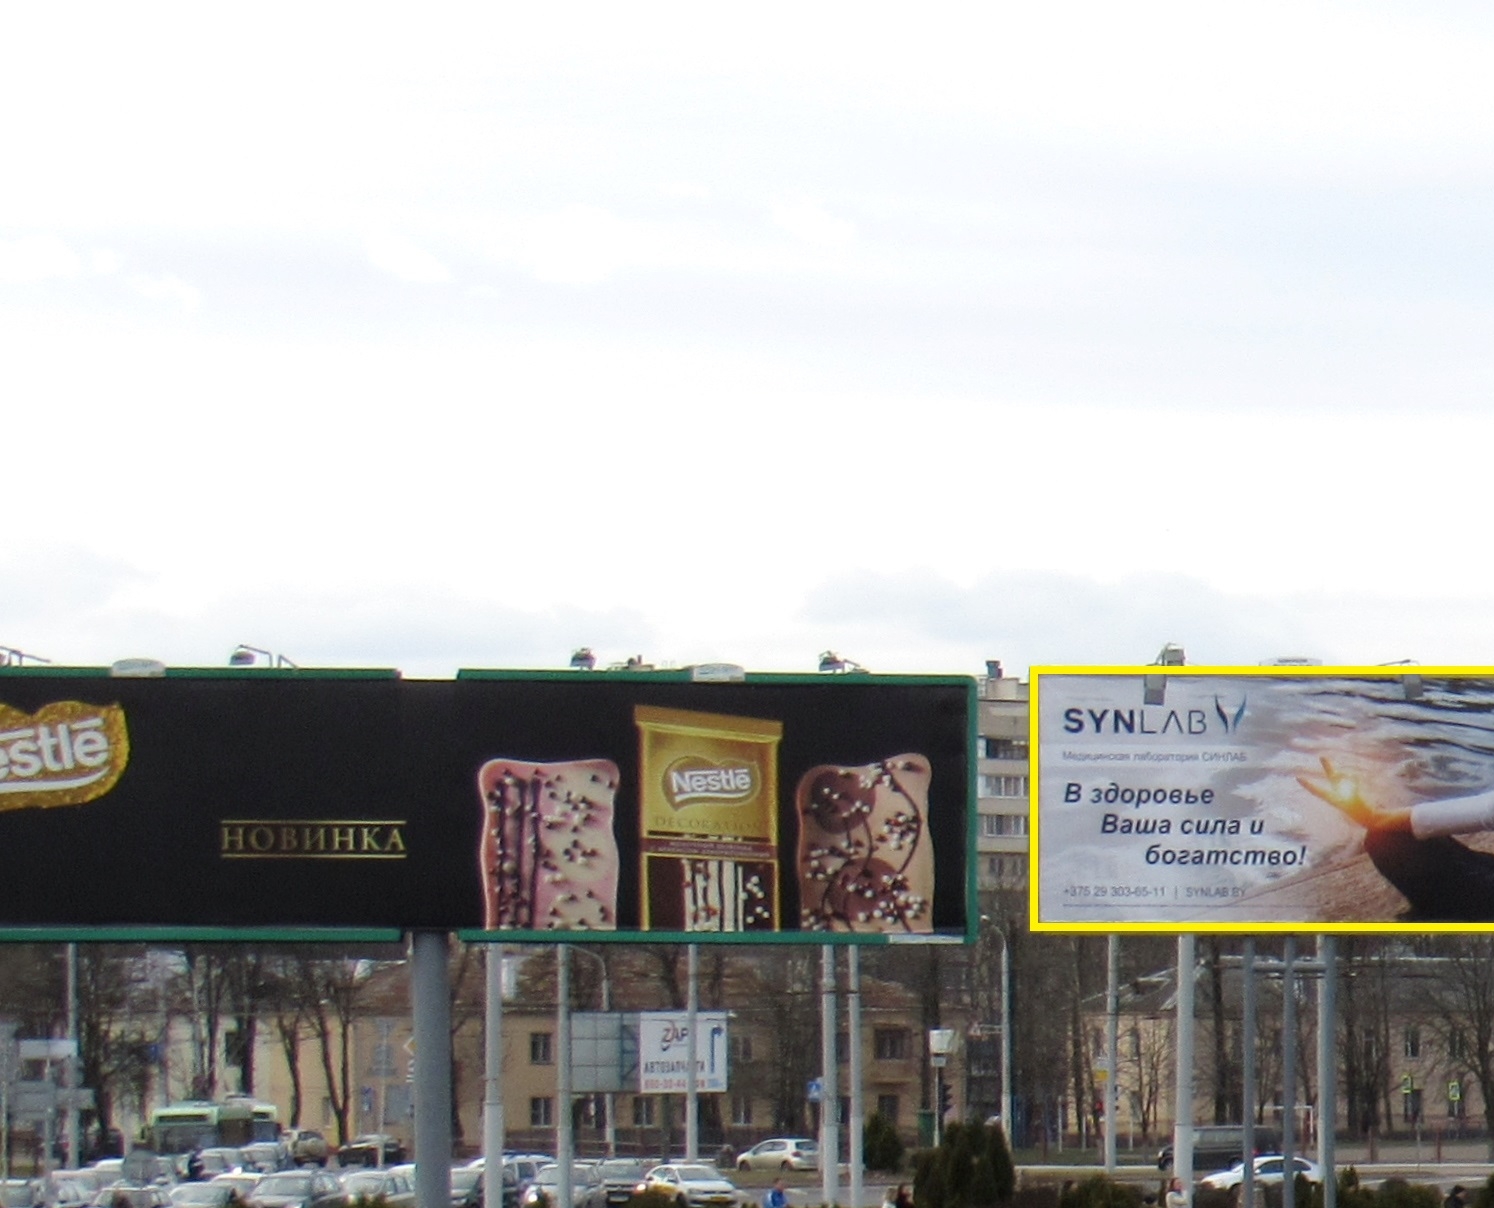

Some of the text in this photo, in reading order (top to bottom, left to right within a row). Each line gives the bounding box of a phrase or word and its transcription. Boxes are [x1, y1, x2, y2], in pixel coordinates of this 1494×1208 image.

[1063, 707, 1207, 735] SYNLAB
[1062, 751, 1248, 763] Медицинская лаборатория СИНЛАБ
[1064, 782, 1215, 809] В здоровье
[1101, 813, 1265, 835] Ваша сила и
[221, 826, 406, 852] НОВИНКА
[1145, 844, 1308, 866] богатство!
[1063, 886, 1091, 897] +375
[1093, 886, 1108, 897] 29
